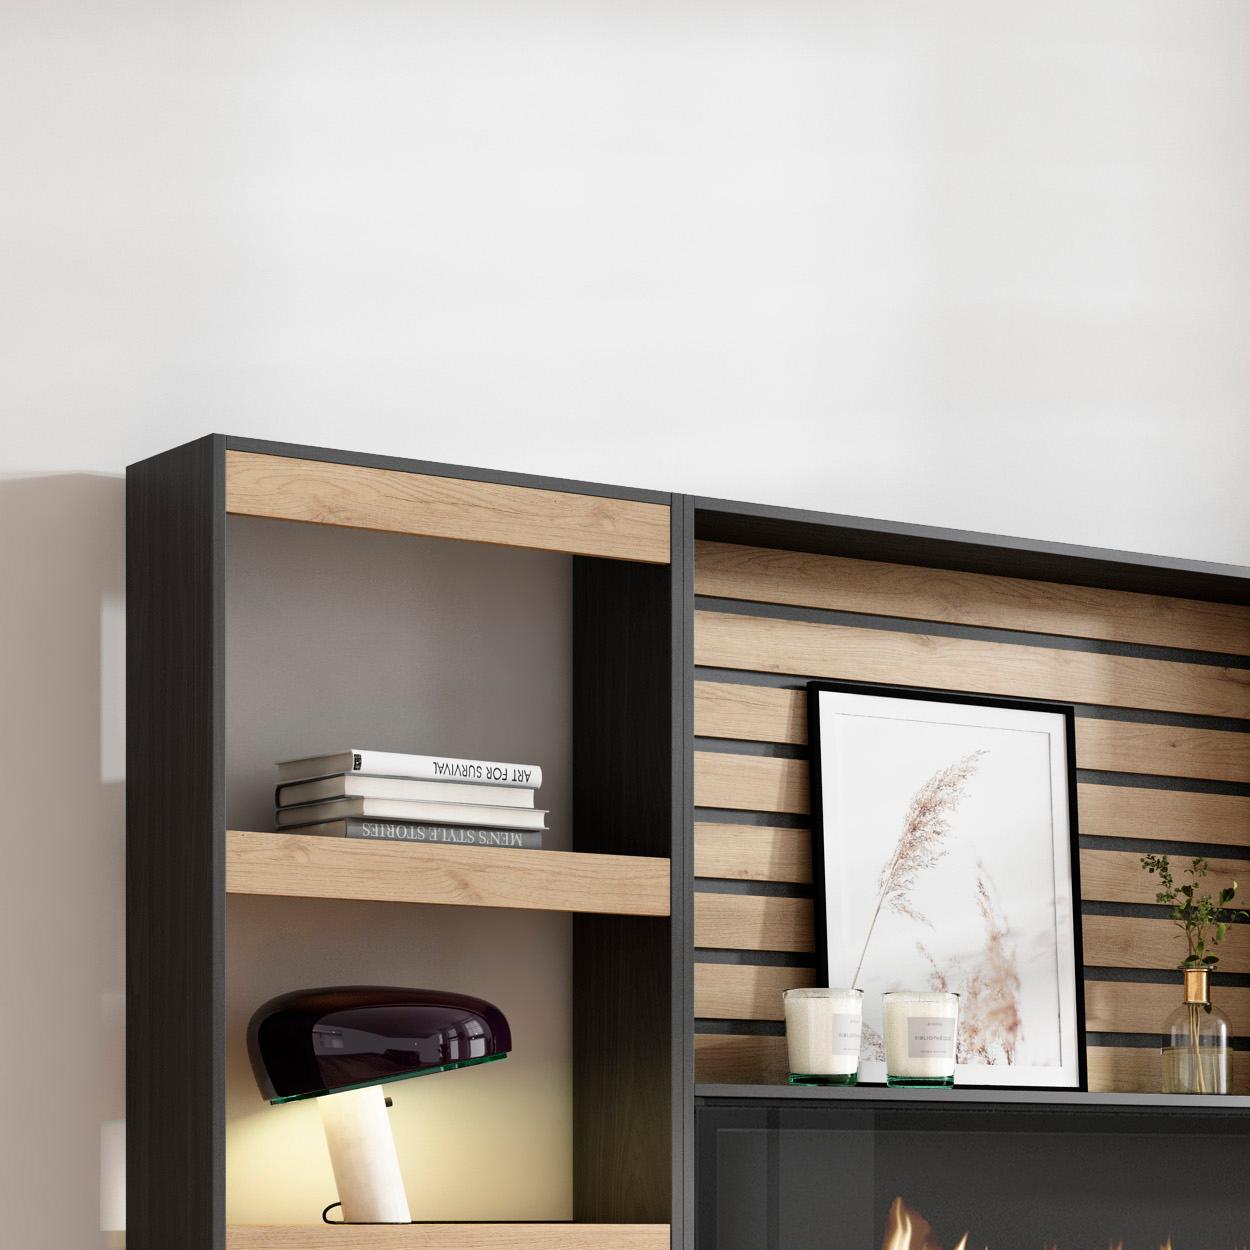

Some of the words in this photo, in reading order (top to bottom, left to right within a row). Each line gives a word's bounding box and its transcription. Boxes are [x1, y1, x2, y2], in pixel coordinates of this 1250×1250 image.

[433, 761, 483, 779] SURVIVAL
[486, 767, 508, 781] FOR
[511, 769, 532, 783] ART
[361, 822, 426, 840] STORIES
[428, 826, 475, 843] STYLE
[478, 831, 523, 847] MEN'S
